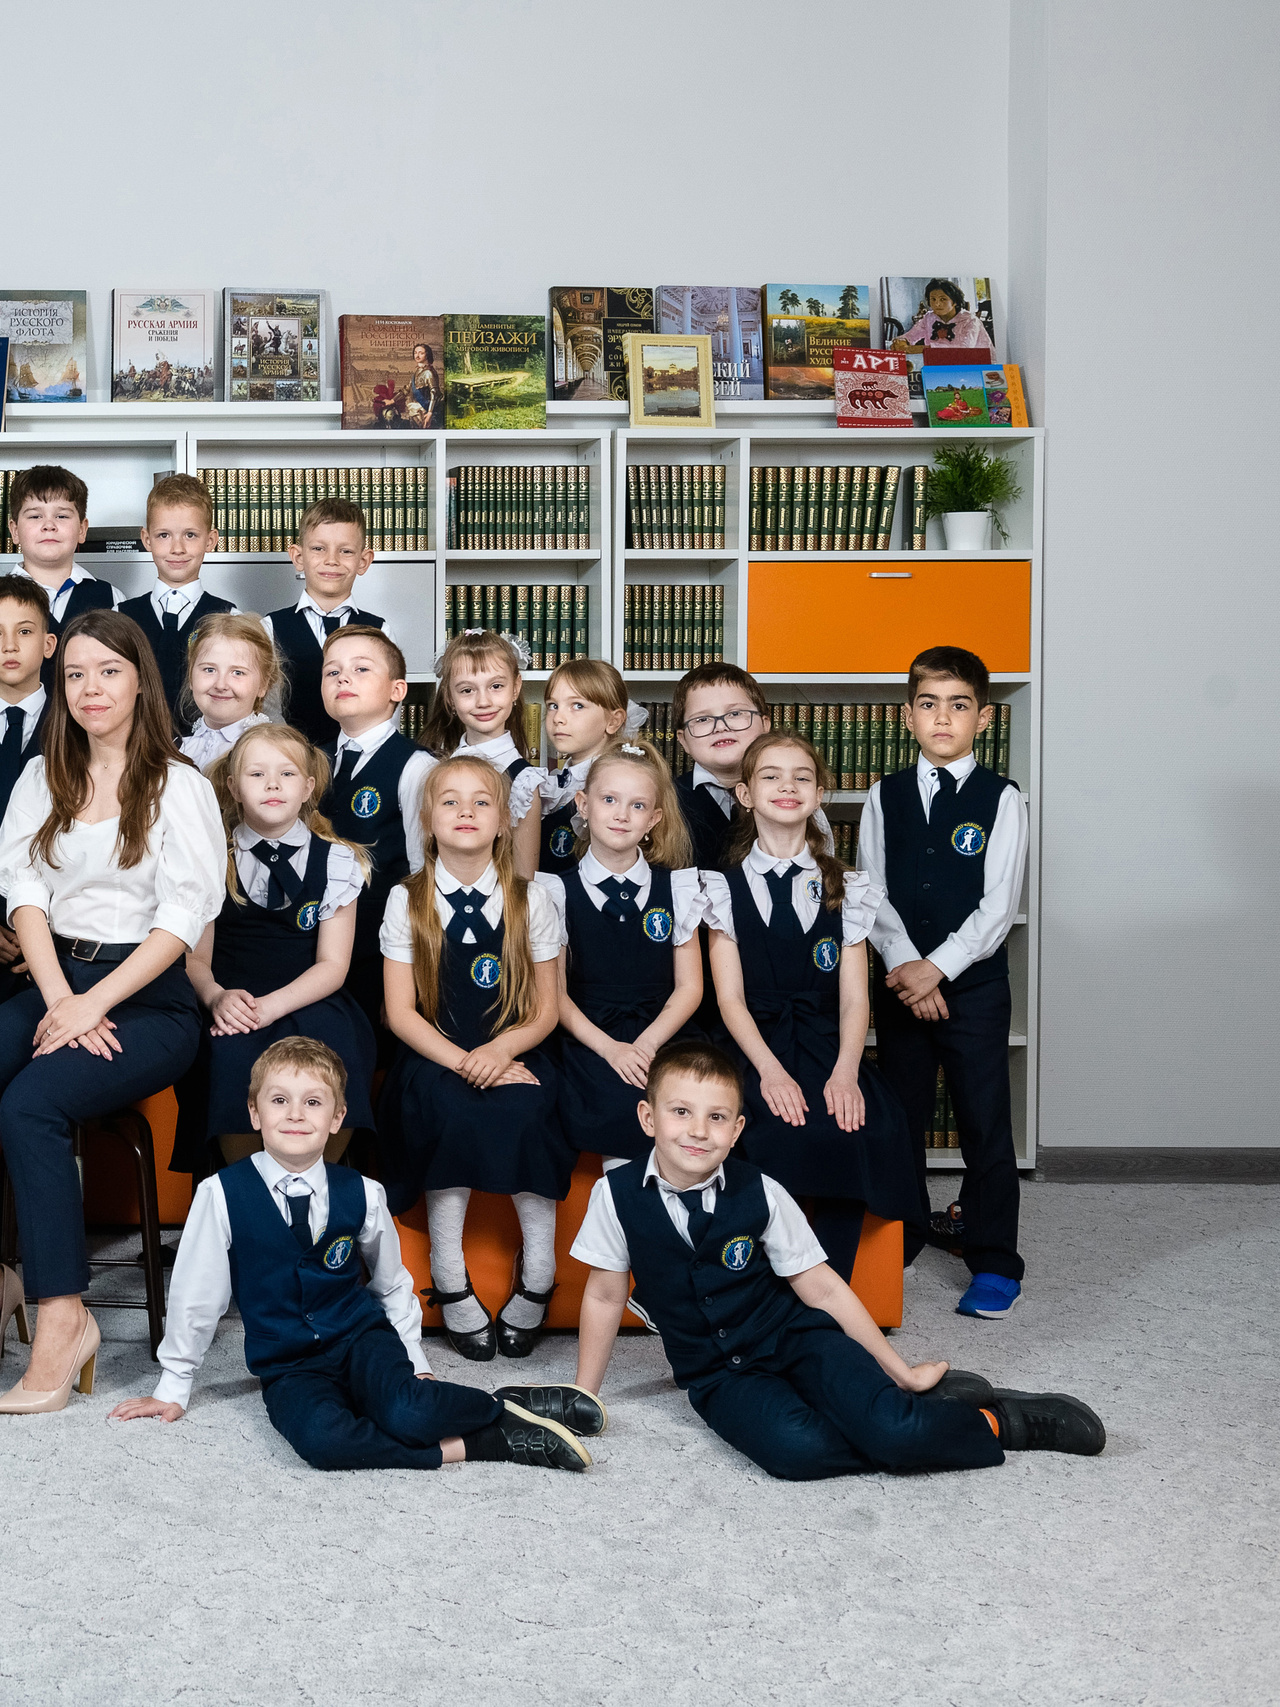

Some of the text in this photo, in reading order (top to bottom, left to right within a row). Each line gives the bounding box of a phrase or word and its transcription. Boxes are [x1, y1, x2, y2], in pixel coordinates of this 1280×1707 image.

[14, 308, 58, 317] ИСТОРИЯ
[10, 317, 64, 327] РУССКОГО
[127, 320, 198, 329] РУССКАЯ АРМИЯ
[16, 328, 55, 336] ФЛОТА
[361, 332, 425, 340] РОССИЙСКОЙ
[448, 329, 537, 345] ПЕЙЗАЖИ
[809, 337, 852, 346] ВЕЛИКИЕ
[852, 353, 899, 371] АРТ
